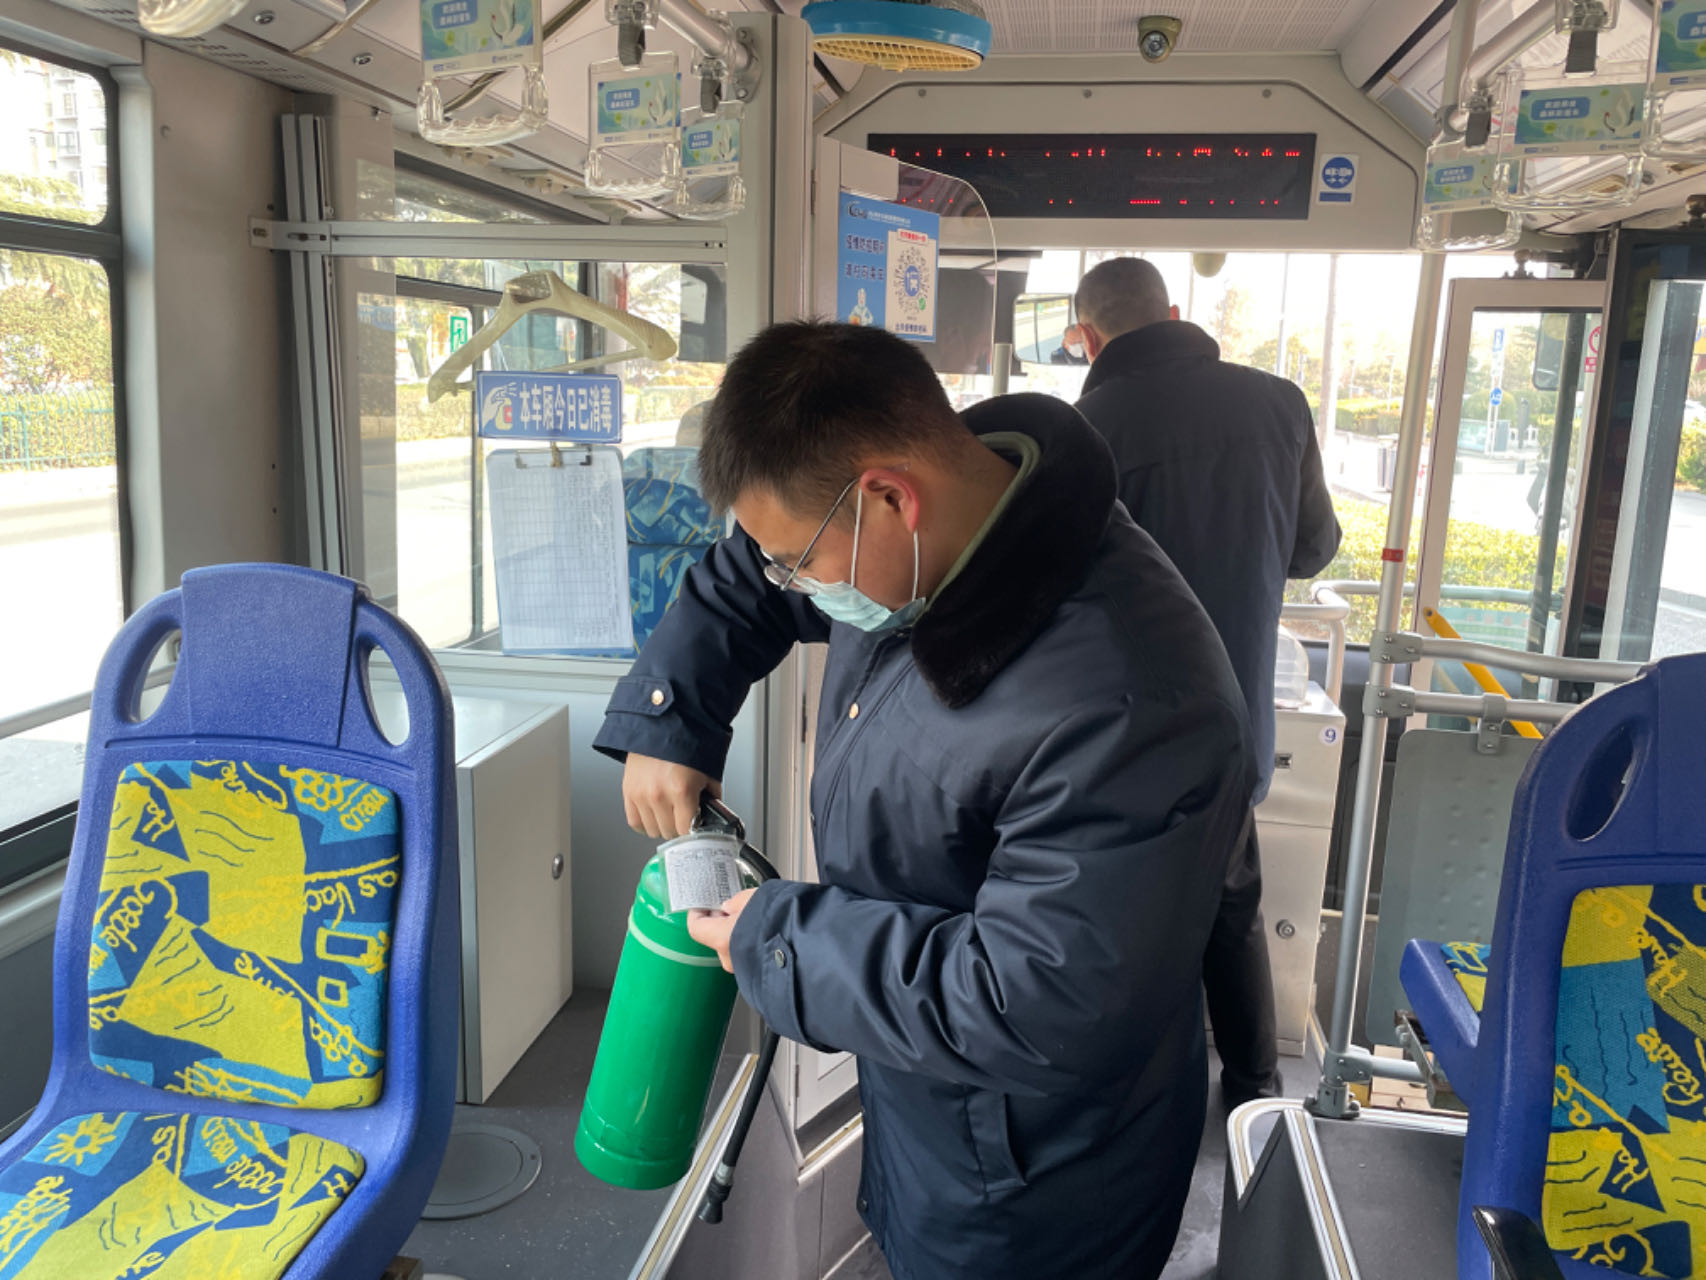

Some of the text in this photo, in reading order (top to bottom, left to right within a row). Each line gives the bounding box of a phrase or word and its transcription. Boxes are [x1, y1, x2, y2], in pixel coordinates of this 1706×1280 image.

[519, 382, 612, 433] 本车厢今日已消毒
[1324, 727, 1337, 743] 9
